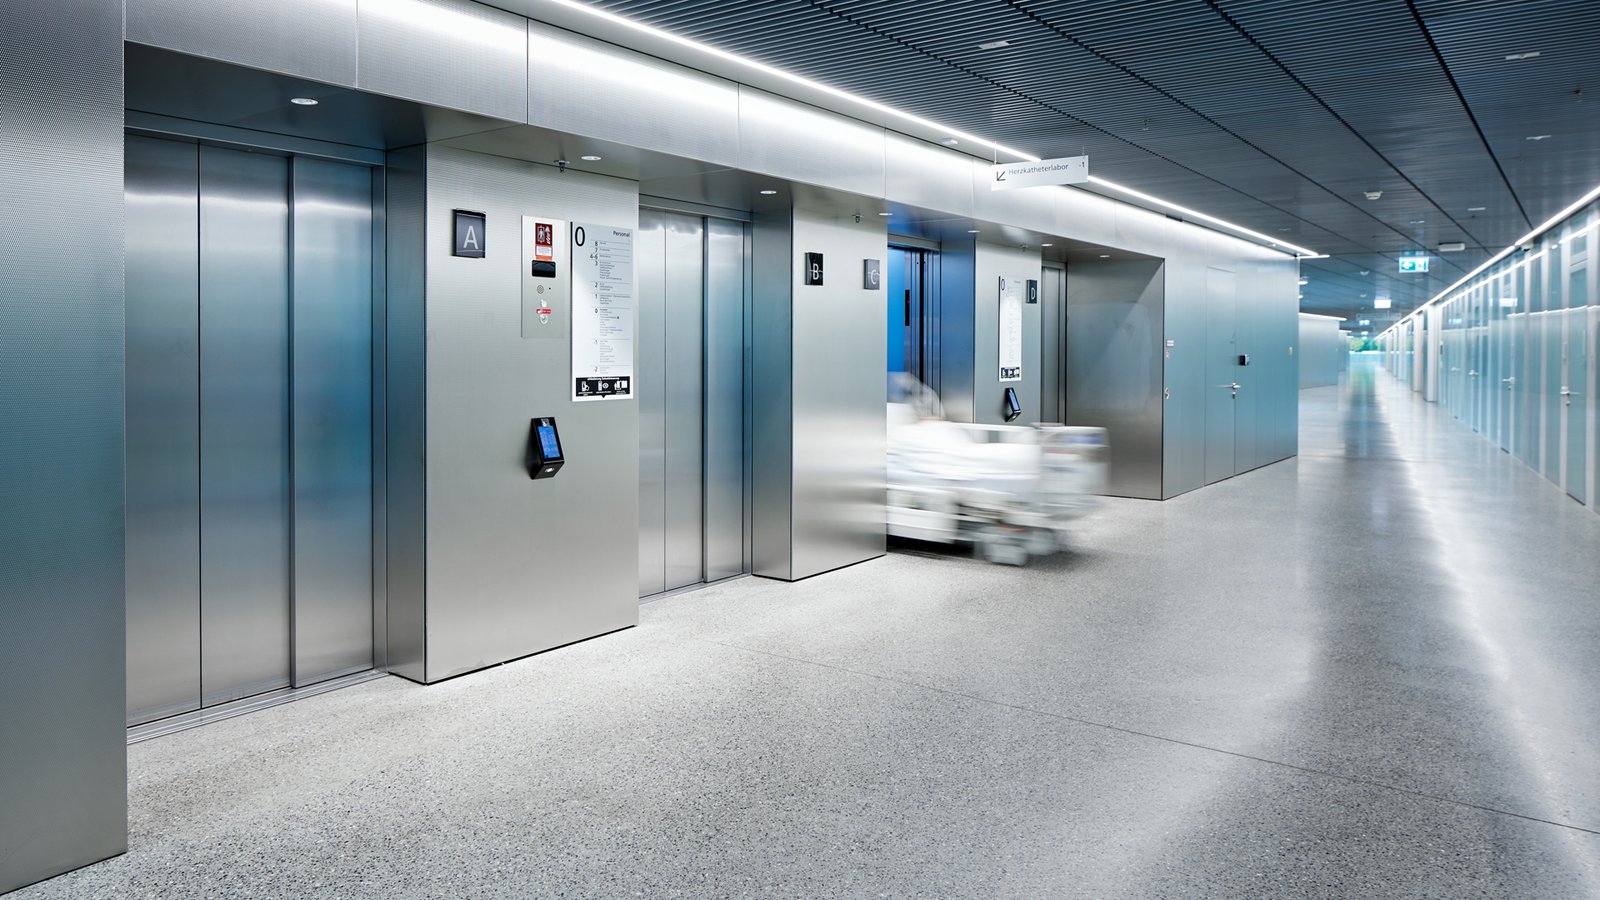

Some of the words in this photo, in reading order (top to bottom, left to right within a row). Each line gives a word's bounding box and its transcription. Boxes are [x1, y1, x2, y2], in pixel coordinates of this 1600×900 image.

[1008, 163, 1069, 176] Herzkatheterlabor
[463, 225, 479, 250] A
[613, 230, 630, 238] Personal
[812, 263, 819, 280] B
[870, 269, 877, 285] C
[1031, 287, 1035, 300] D
